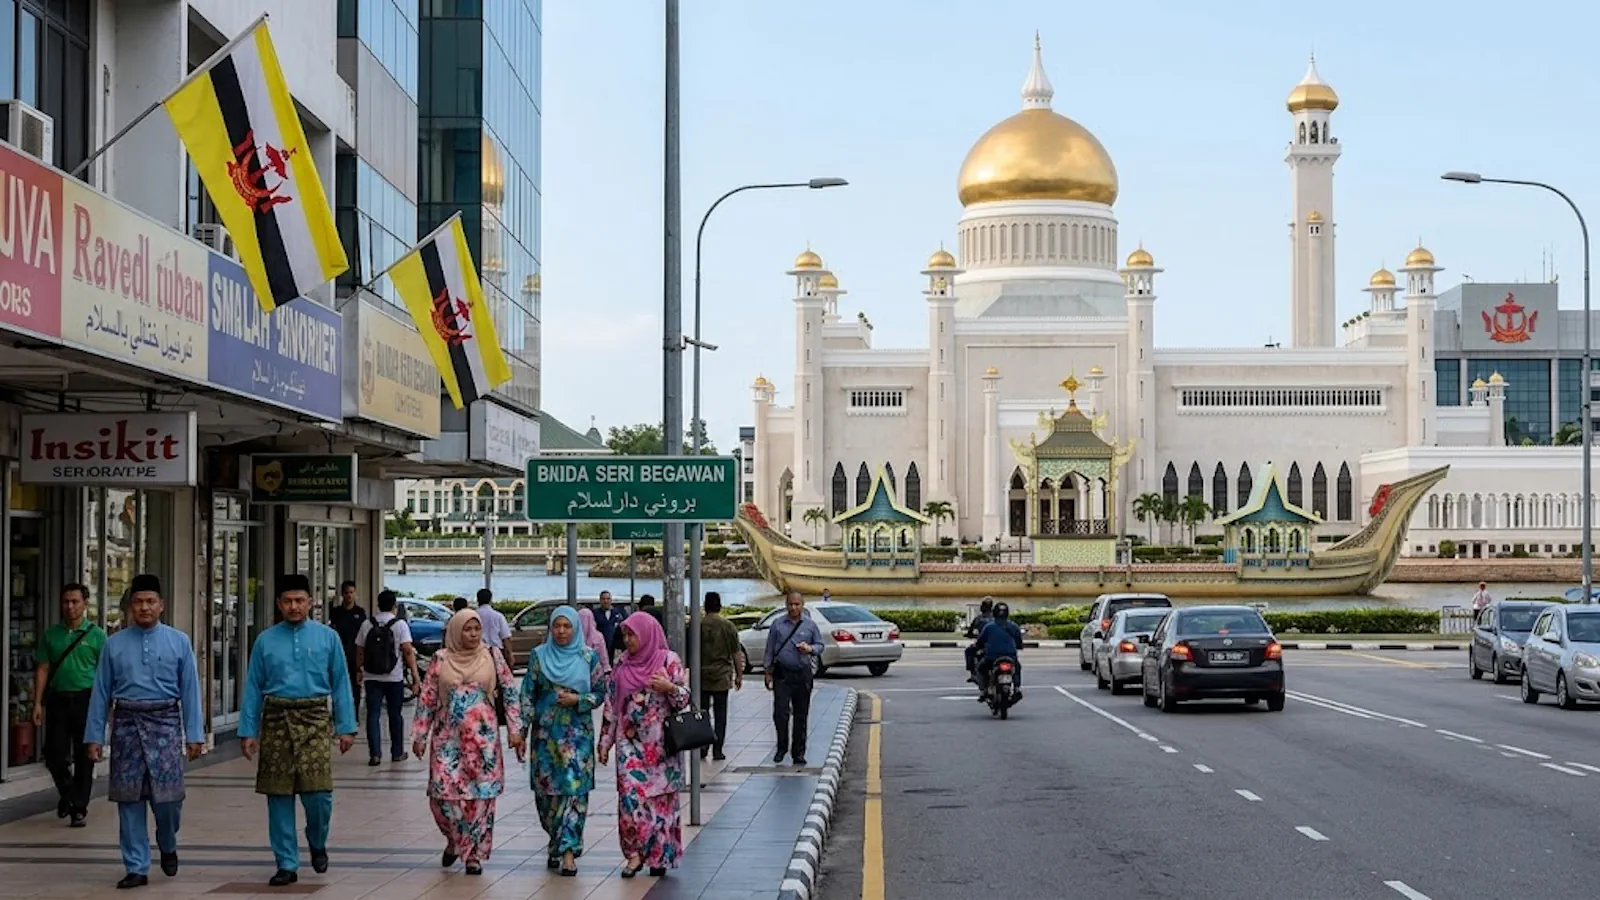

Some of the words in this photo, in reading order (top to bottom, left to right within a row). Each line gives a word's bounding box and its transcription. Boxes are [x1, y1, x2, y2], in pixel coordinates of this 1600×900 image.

[30, 419, 179, 463] Insikit
[595, 465, 634, 482] SERI
[640, 465, 725, 482] BEGAWAN
